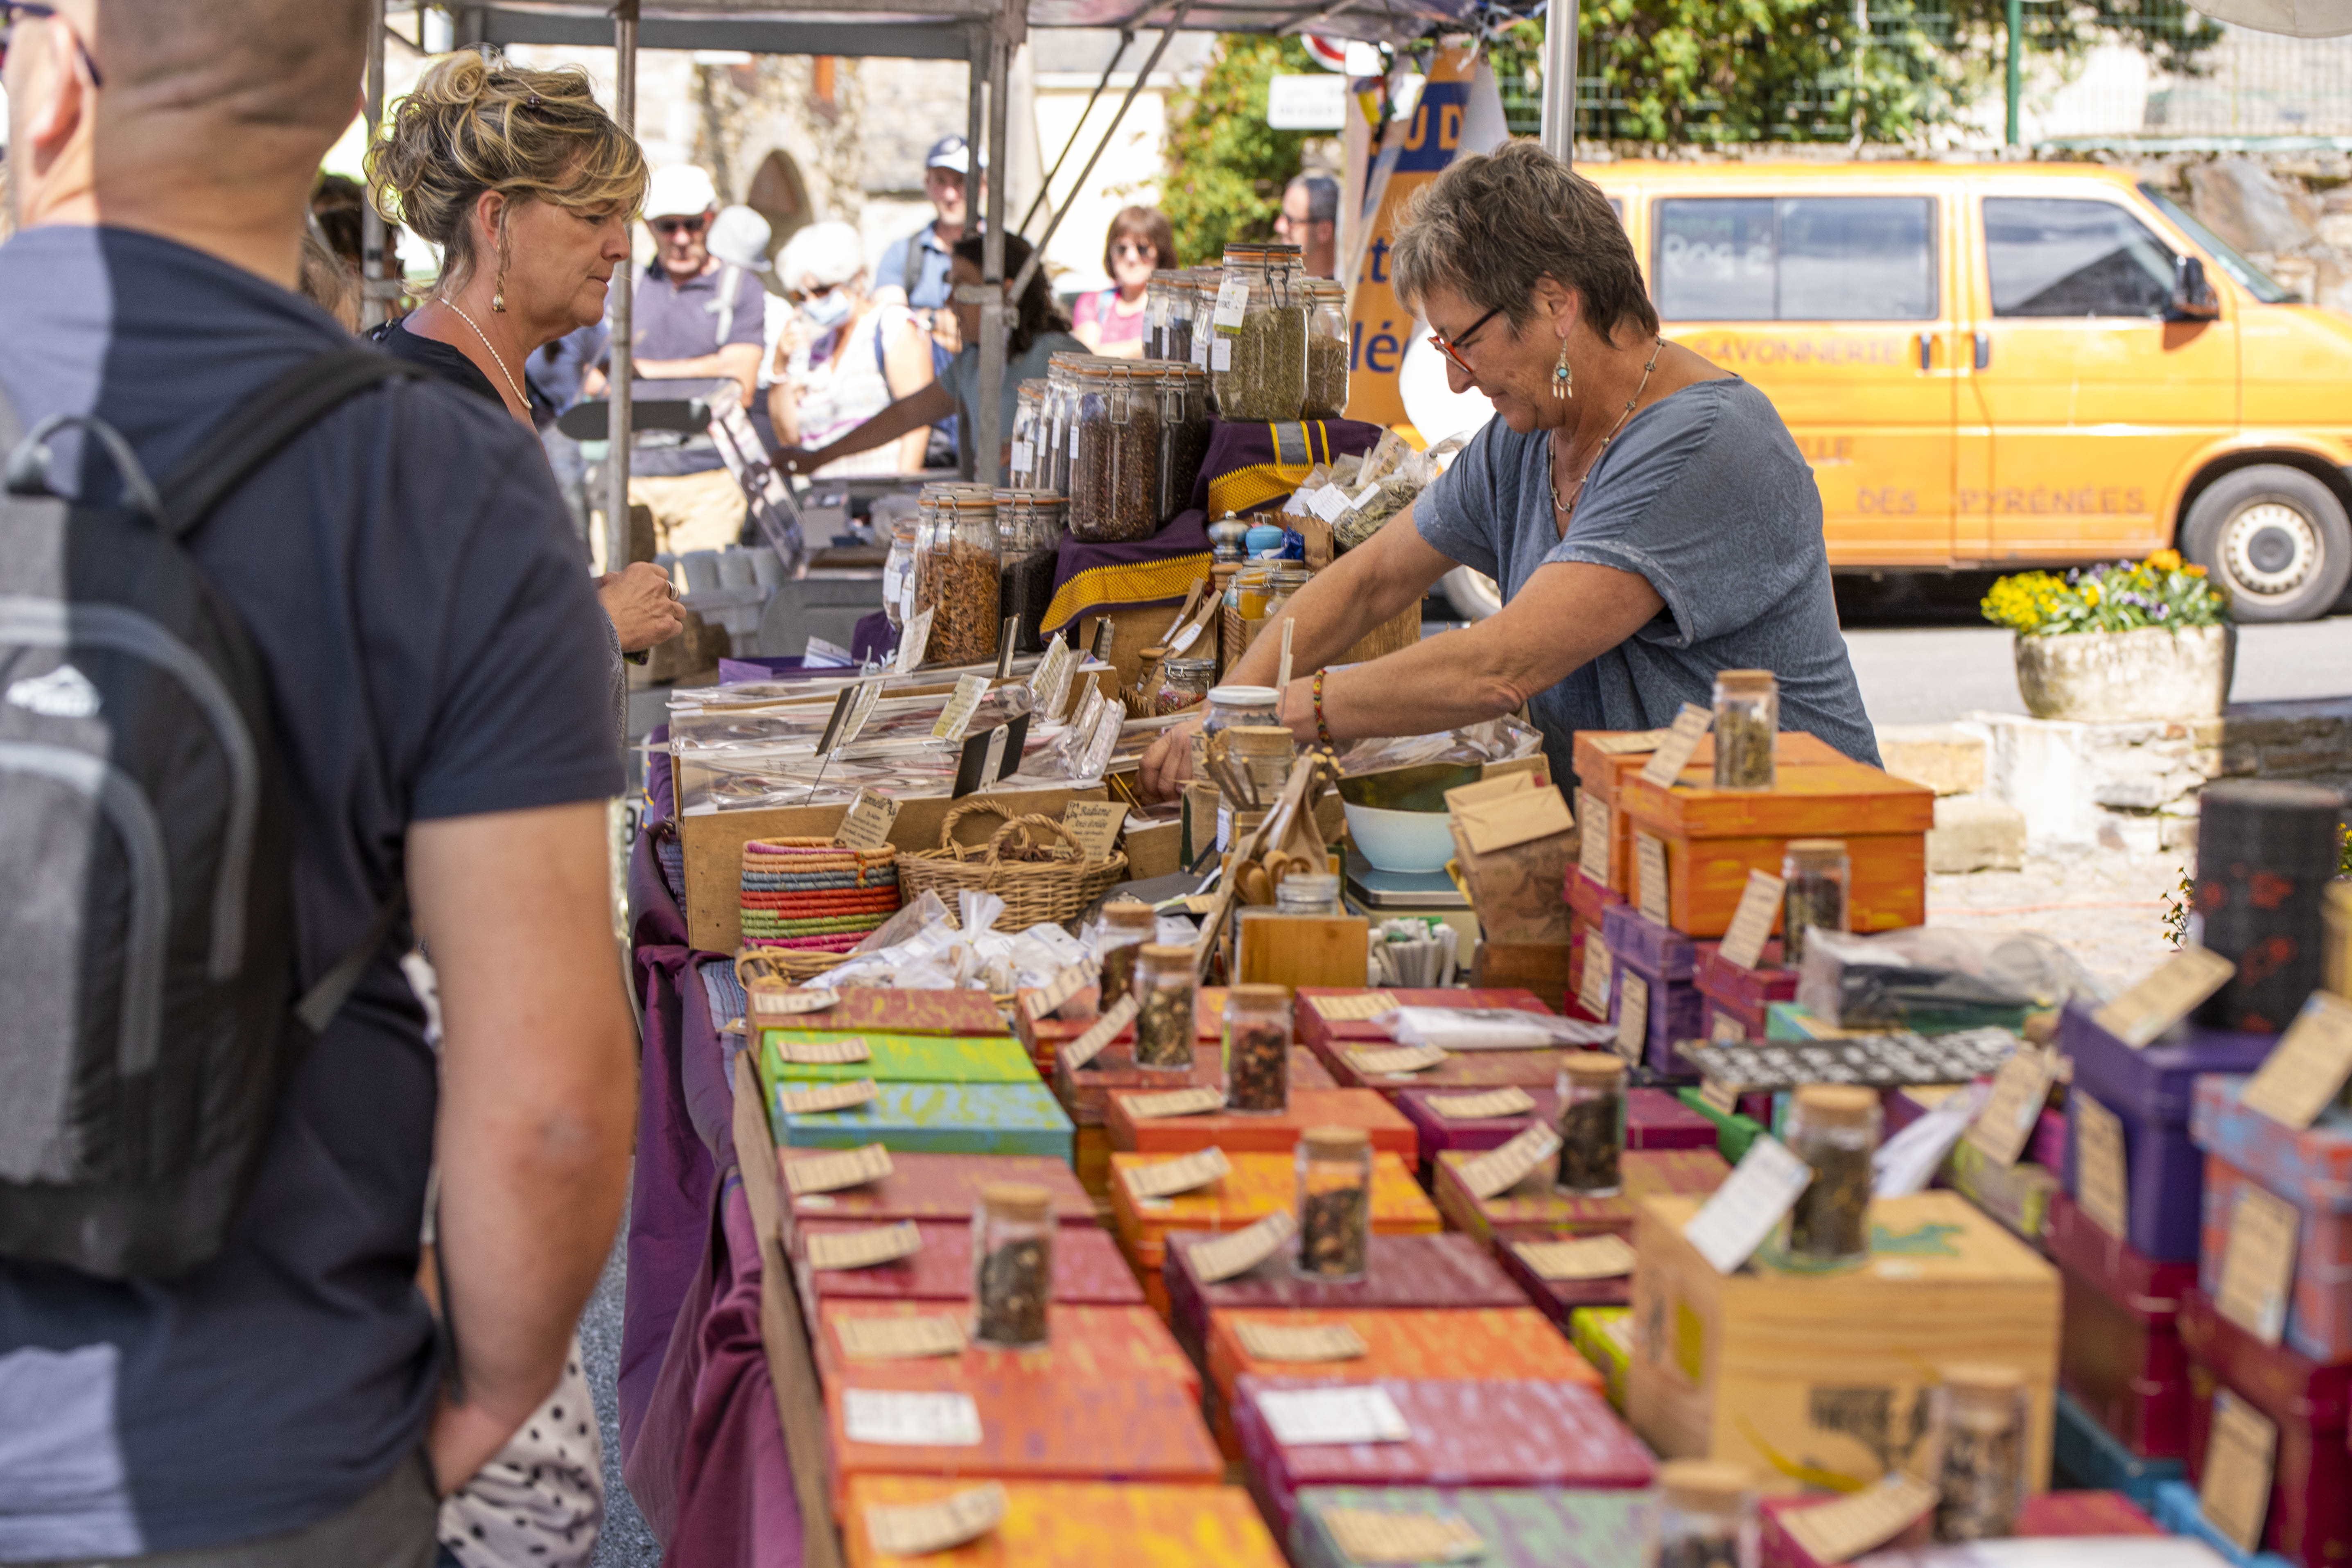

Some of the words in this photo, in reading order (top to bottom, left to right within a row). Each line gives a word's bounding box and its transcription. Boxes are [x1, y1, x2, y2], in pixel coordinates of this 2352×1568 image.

[1351, 320, 1408, 373] lé
[1695, 337, 1900, 366] SAVONNERIE
[1796, 436, 1853, 462] LLE
[1857, 486, 1918, 515] DES
[1959, 483, 2146, 515] PYRÉNÉES
